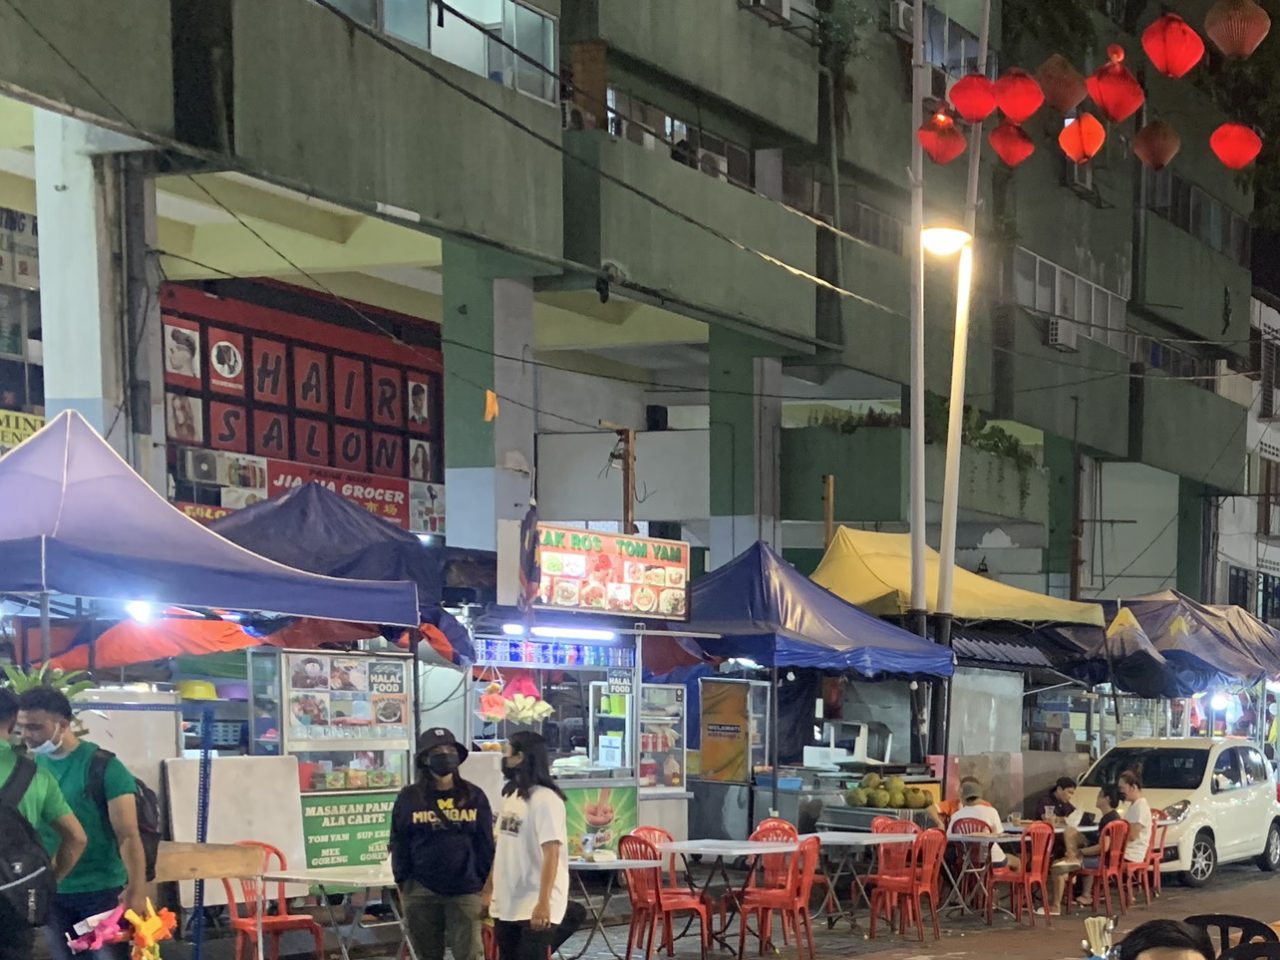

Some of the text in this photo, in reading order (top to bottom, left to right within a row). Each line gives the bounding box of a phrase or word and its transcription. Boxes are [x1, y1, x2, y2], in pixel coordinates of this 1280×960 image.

[257, 351, 398, 420] HAIR
[218, 406, 398, 469] SALON
[342, 483, 405, 504] GROCER
[615, 539, 648, 558] TOM
[652, 544, 682, 563] YAM
[370, 674, 401, 684] HALAL
[609, 677, 631, 686] HALAL
[373, 683, 400, 693] FOOD
[610, 684, 631, 694] FOOD
[305, 804, 364, 817] MASAKAN
[322, 813, 385, 827] ALA CARTE
[308, 833, 350, 844] TOM YAM
[357, 831, 373, 839] SUP
[321, 848, 341, 857] MEE
[311, 855, 348, 866] GORENG
